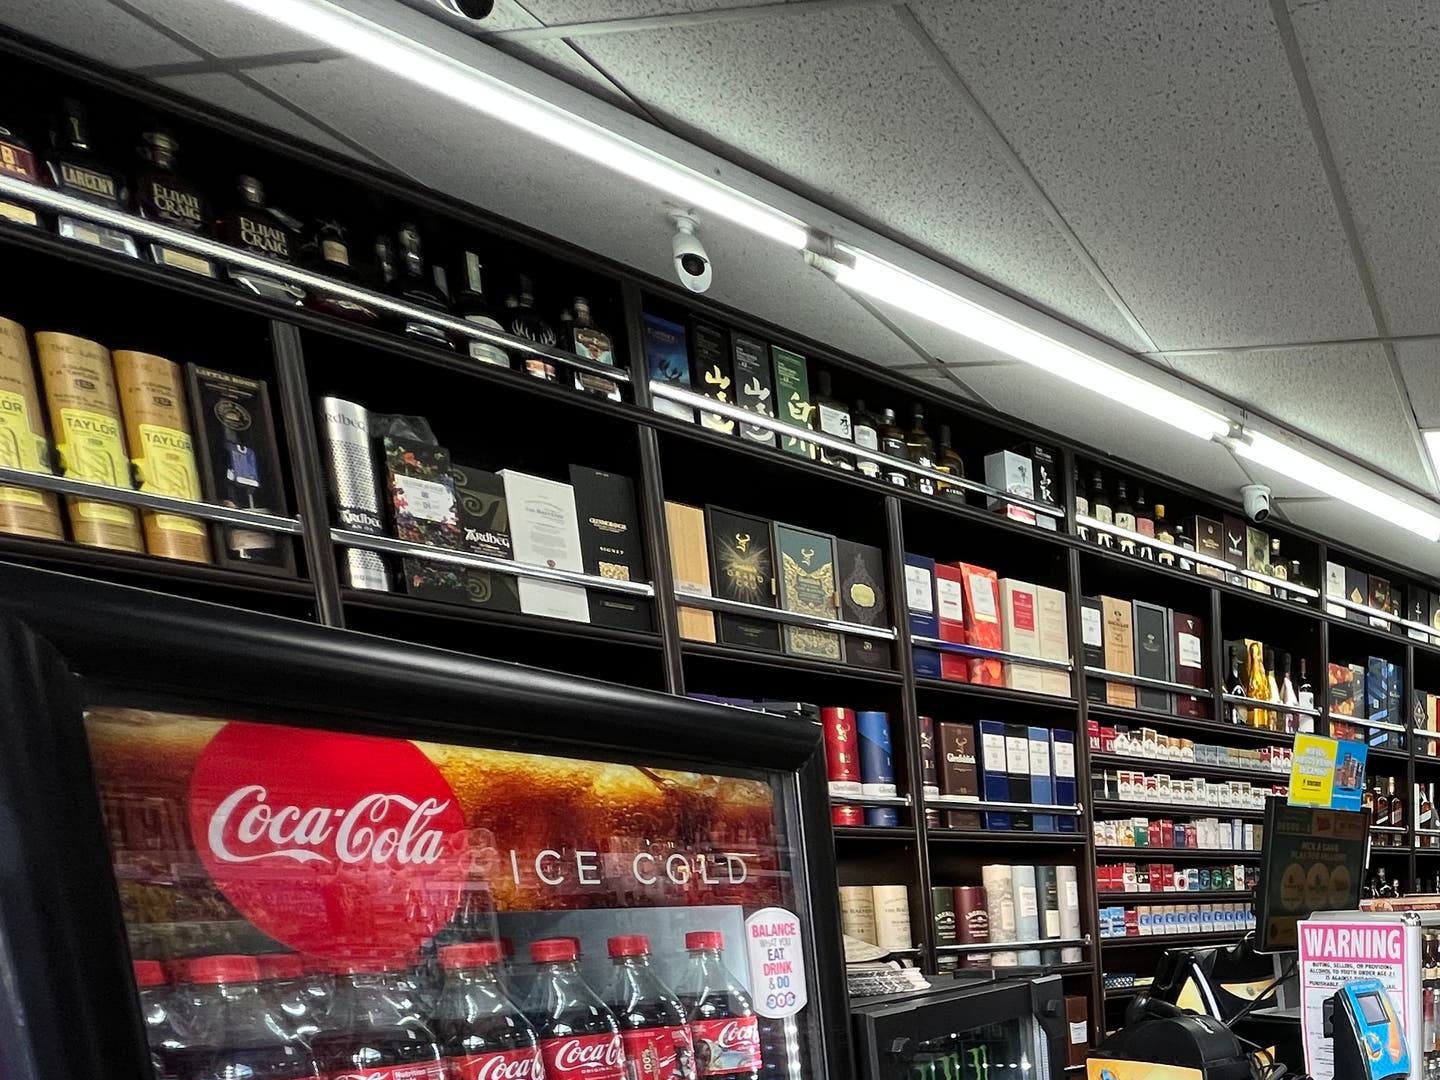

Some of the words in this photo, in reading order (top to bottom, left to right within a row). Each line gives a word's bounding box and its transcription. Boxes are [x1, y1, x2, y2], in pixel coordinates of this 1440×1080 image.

[61, 163, 115, 199] LARCENY
[153, 183, 200, 206] ELIJAH
[154, 196, 201, 220] CRAIG
[240, 217, 286, 243] ELIJAH
[241, 231, 288, 255] CRAIG
[66, 417, 118, 437] TAYLOR
[145, 432, 193, 451] TAYLOR
[207, 785, 450, 866] Coca-Cola
[510, 848, 600, 887] ICE
[631, 849, 749, 887] COLD
[752, 923, 796, 938] BALANCE
[760, 938, 777, 947] WHAT
[779, 937, 791, 946] YOU
[767, 948, 785, 961] EAT
[1304, 928, 1400, 959] WARNING
[763, 962, 792, 976] DRINK
[777, 975, 790, 988] DO
[555, 1040, 625, 1071] Coca-C
